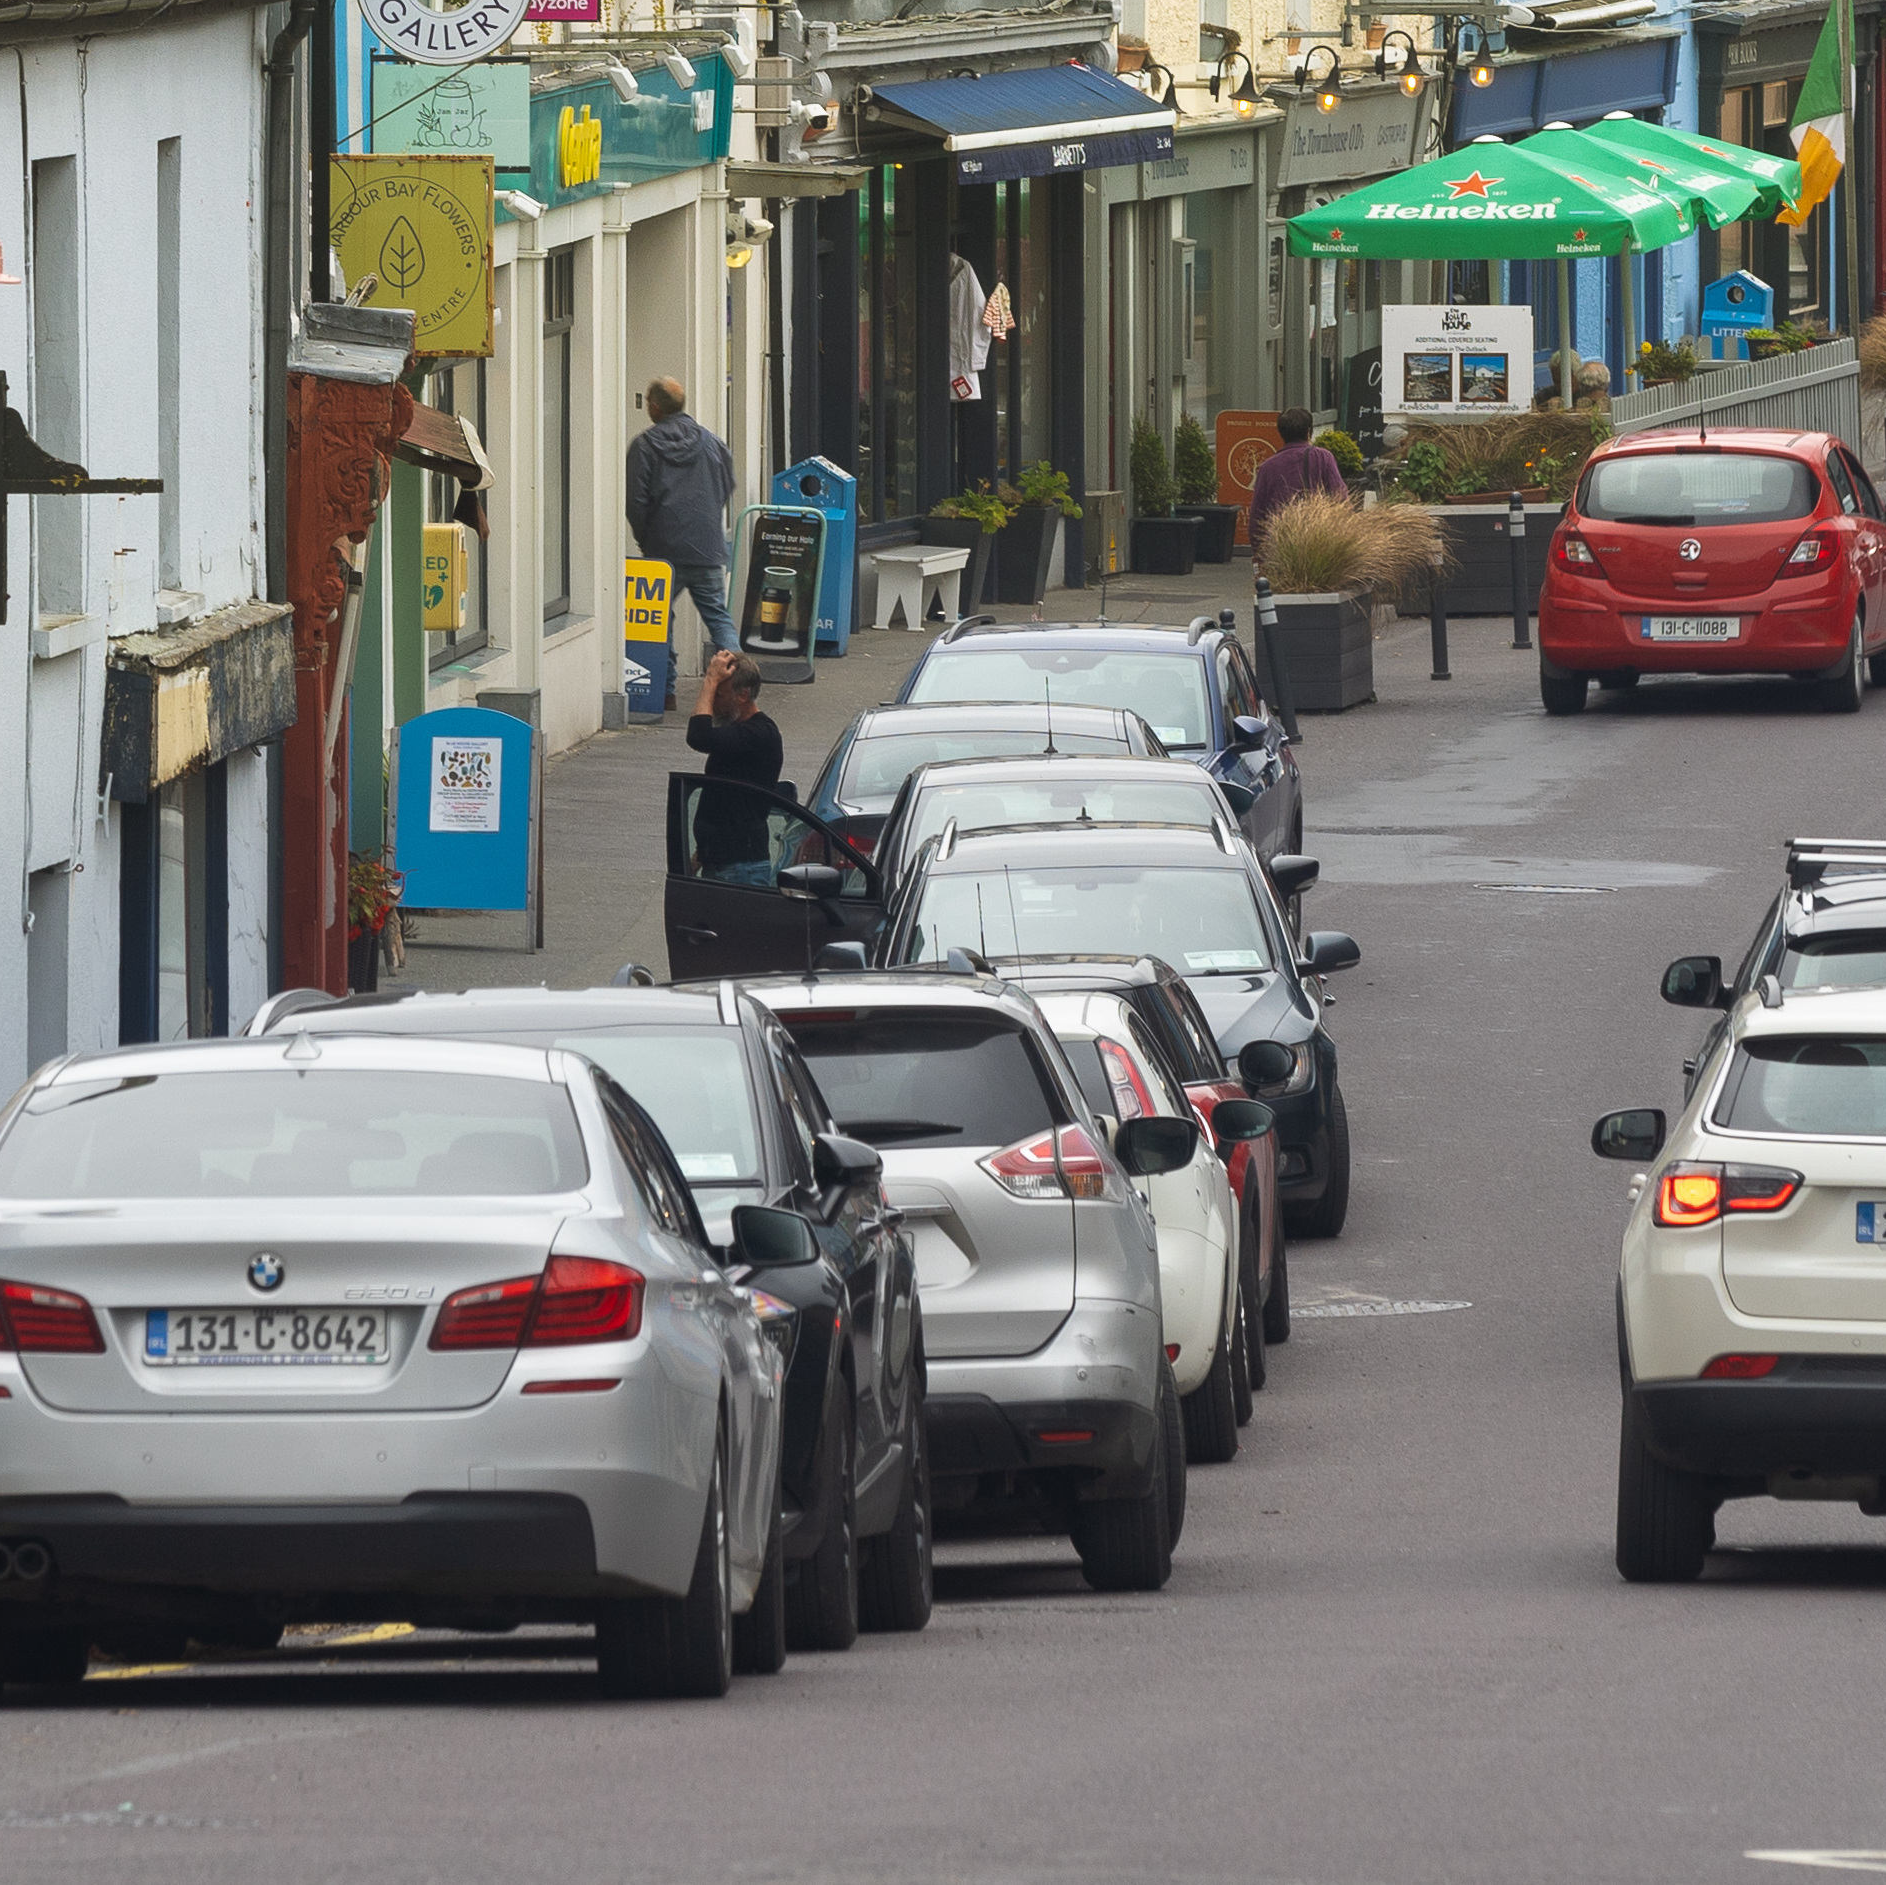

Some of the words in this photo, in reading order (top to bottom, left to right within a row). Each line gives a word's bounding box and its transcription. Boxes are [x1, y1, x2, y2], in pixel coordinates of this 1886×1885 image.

[1365, 201, 1557, 219] Heineken
[385, 181, 419, 198] BAY
[422, 186, 476, 256] FLOWERS
[1312, 242, 1359, 253] Heineken
[1557, 242, 1601, 254] Heineken
[424, 556, 449, 570] ED
[625, 576, 666, 601] TM
[1662, 621, 1728, 635] 131-C-11088
